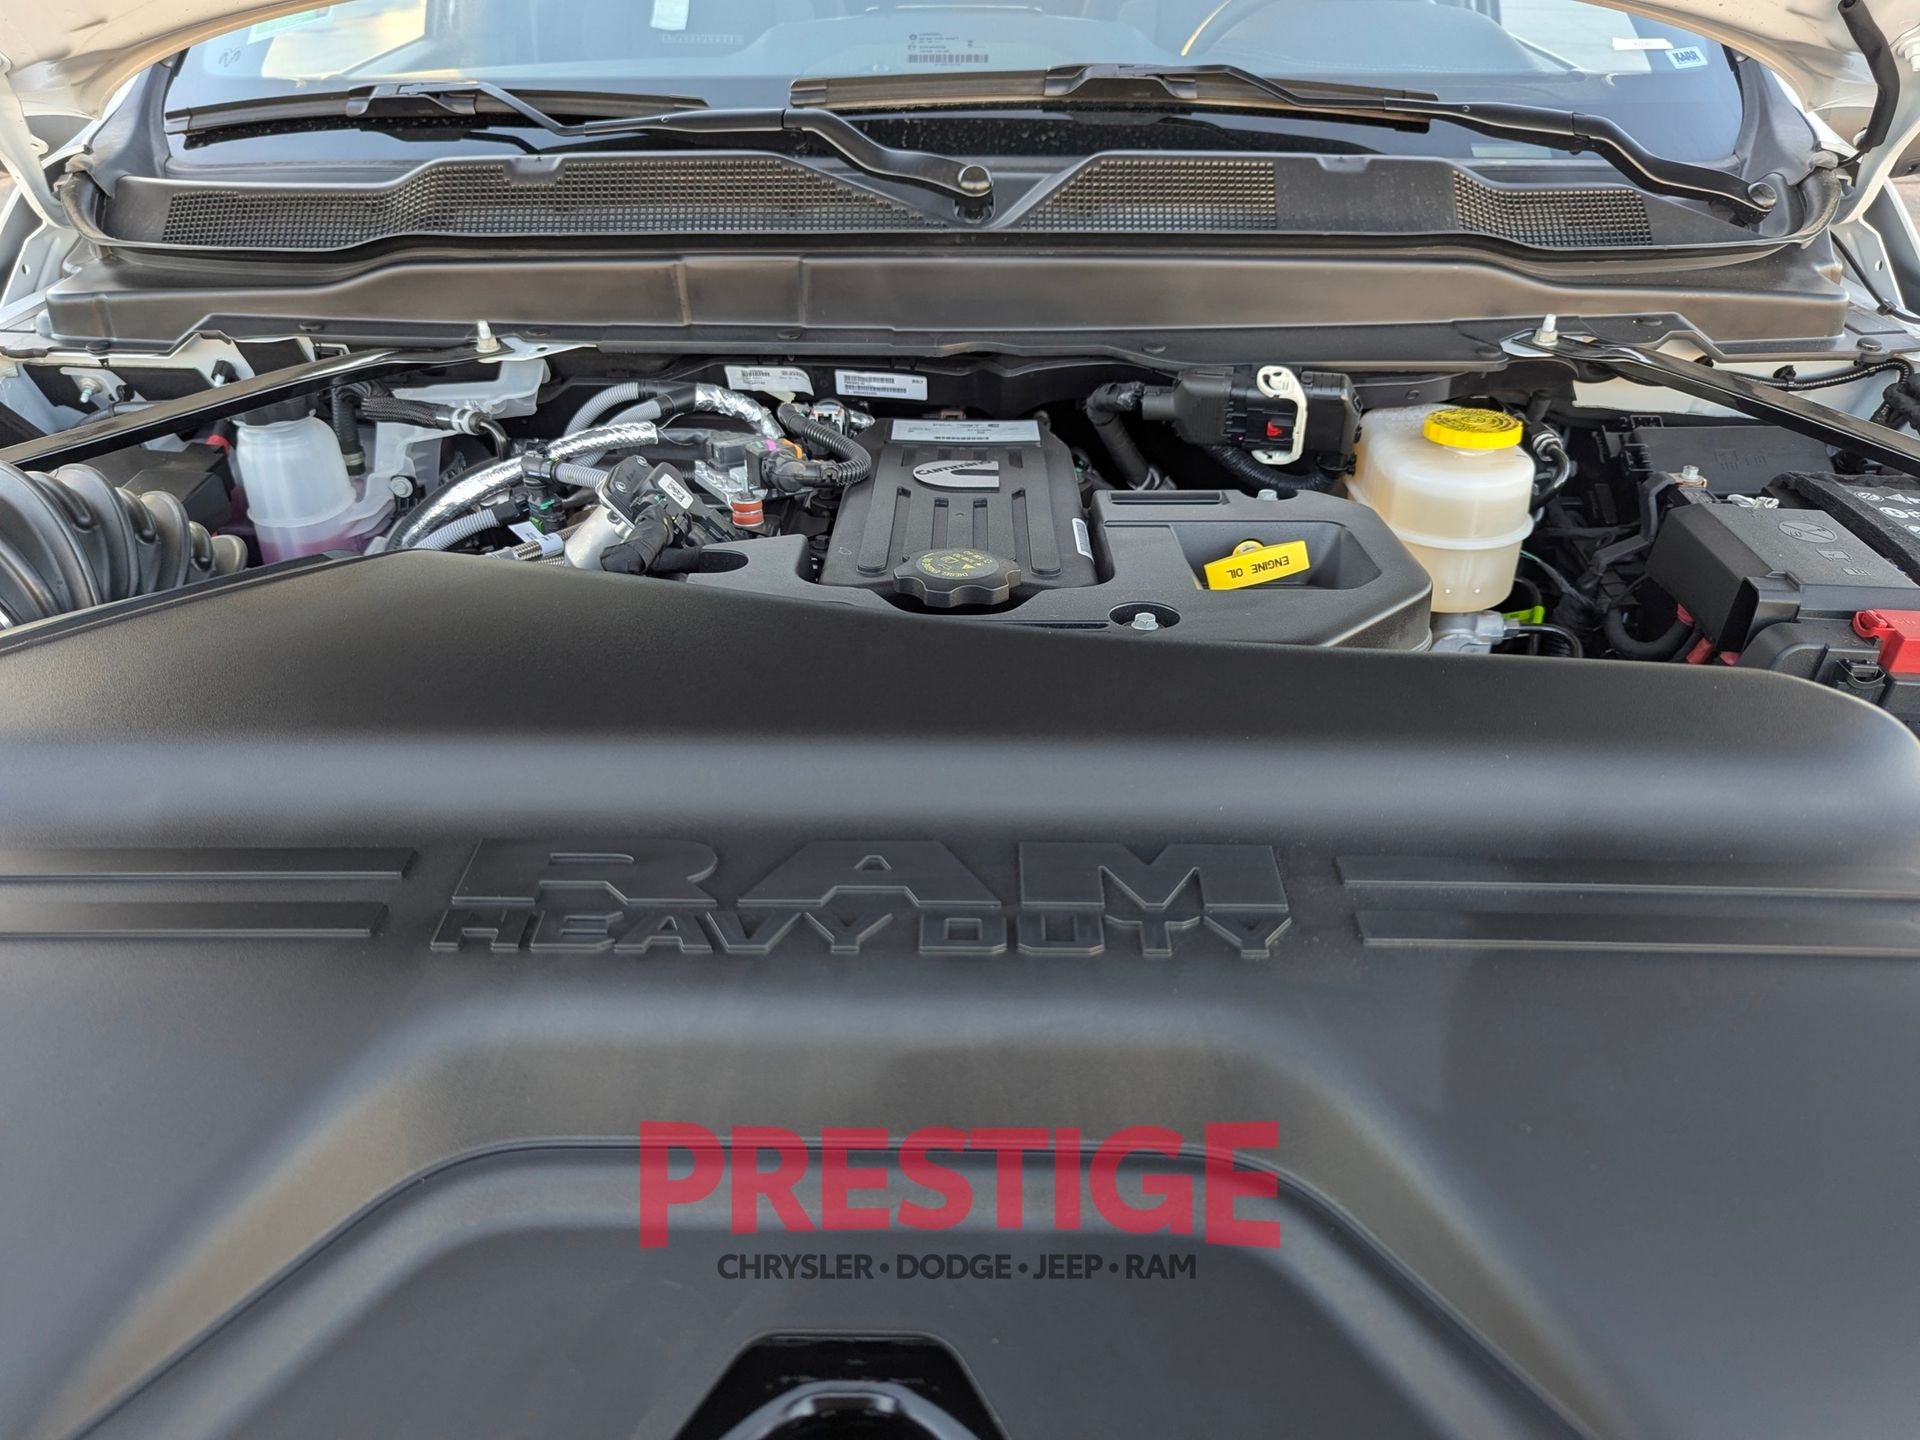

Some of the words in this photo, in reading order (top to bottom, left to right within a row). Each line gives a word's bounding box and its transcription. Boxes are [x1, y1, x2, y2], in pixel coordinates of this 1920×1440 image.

[1226, 567, 1244, 579] OIL
[1250, 555, 1290, 574] ENGINE
[451, 838, 1290, 911] RAM
[430, 907, 893, 954] HEAVY
[918, 908, 1292, 958] DUTY
